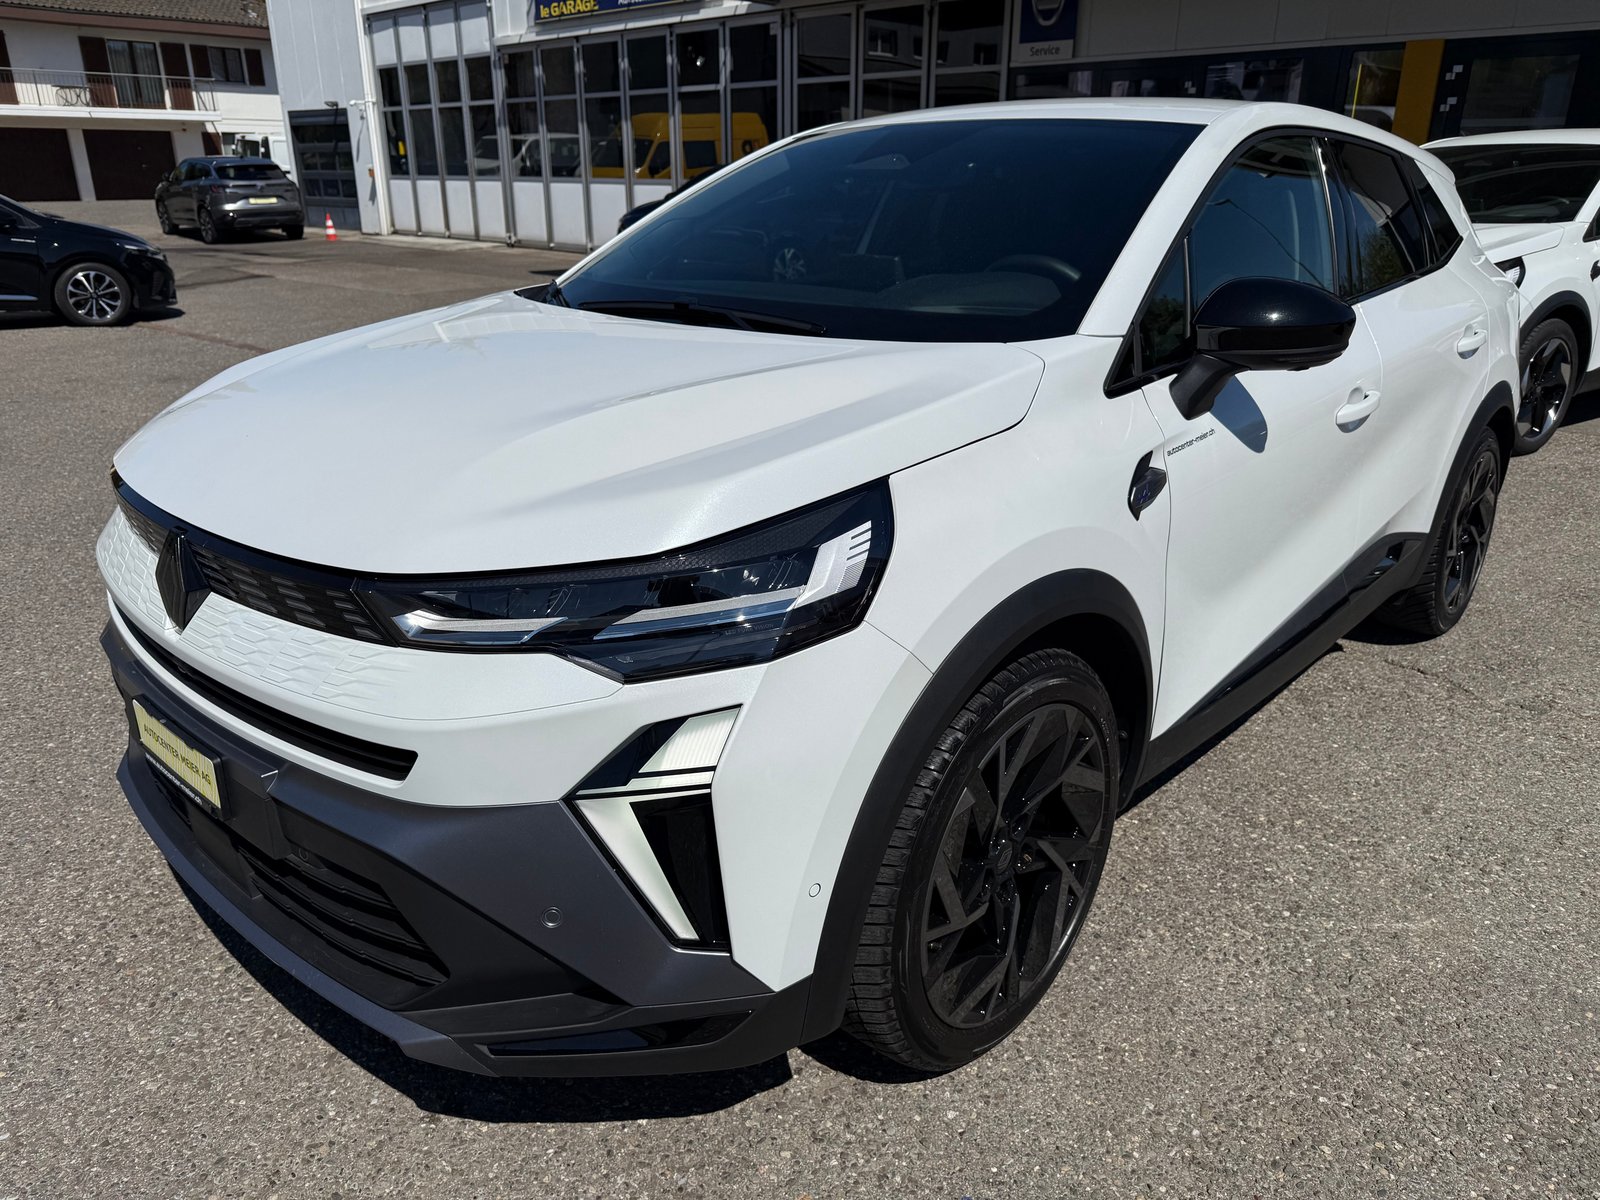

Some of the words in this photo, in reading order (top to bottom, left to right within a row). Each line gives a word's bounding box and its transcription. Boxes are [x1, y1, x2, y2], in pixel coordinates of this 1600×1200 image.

[540, 4, 549, 18] le
[551, 0, 599, 16] GARAGE
[1030, 44, 1060, 57] Service
[1166, 427, 1216, 457] autocenter-meier.ch
[143, 723, 181, 761] AUTOCENTER
[180, 753, 201, 777] MEIER
[201, 770, 212, 785] AG
